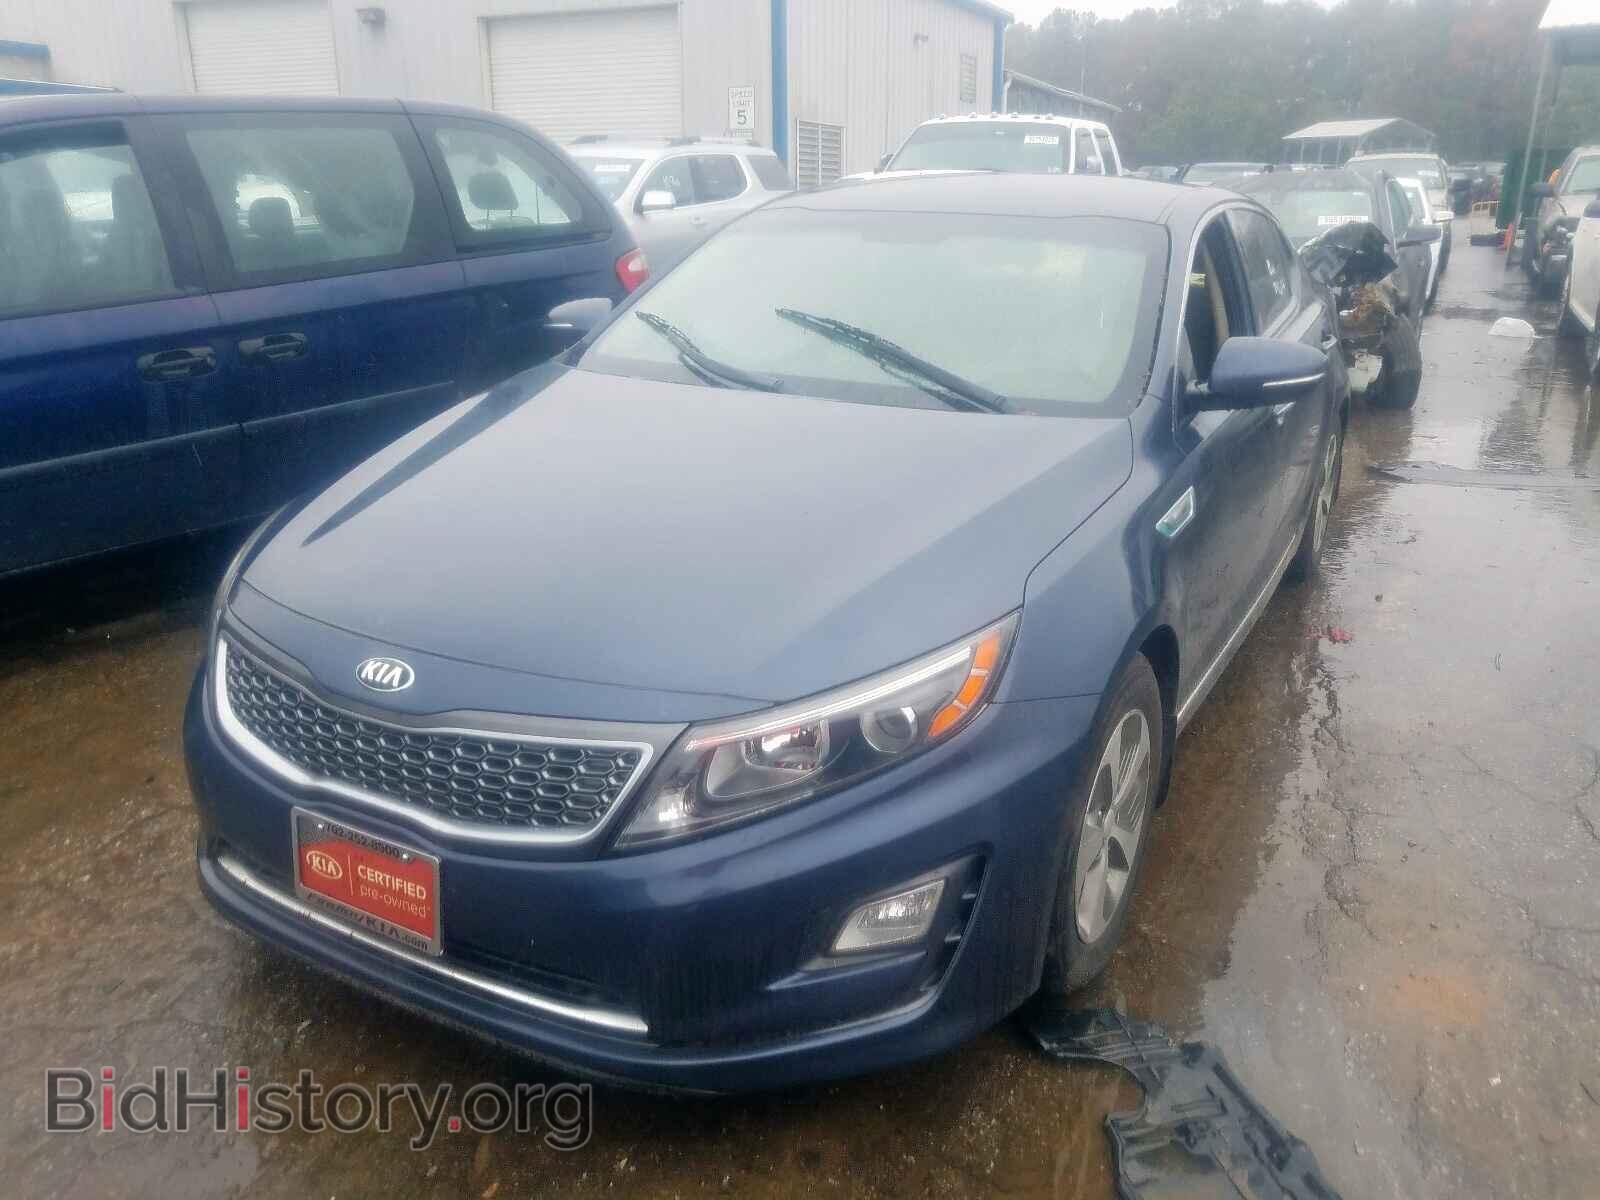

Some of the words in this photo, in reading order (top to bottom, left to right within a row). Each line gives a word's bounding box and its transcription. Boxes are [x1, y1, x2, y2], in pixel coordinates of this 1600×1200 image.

[737, 109, 747, 125] 5
[360, 660, 403, 688] KIA
[311, 853, 339, 877] KIA
[357, 864, 427, 900] CERTIFIED
[359, 884, 427, 919] pre-owned
